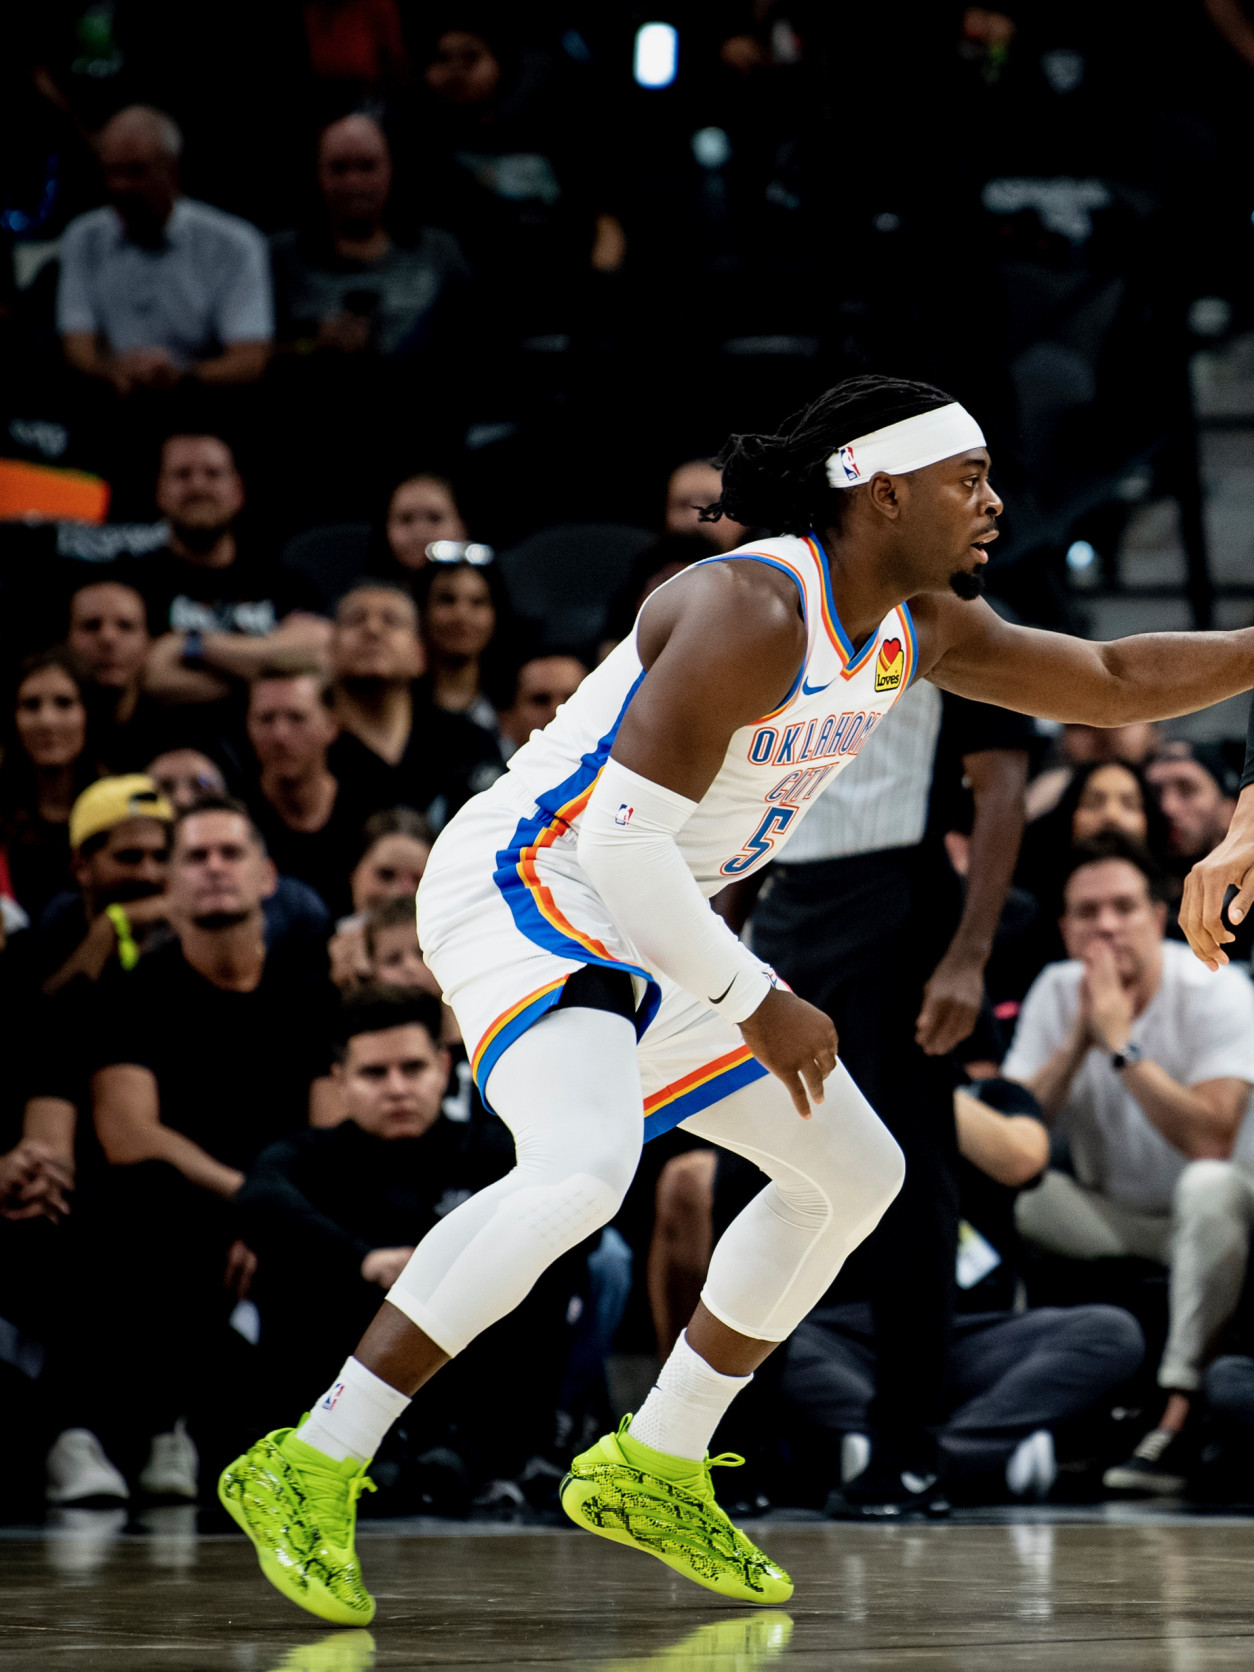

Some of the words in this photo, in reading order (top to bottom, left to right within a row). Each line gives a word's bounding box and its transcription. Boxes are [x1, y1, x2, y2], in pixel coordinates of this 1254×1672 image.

[748, 711, 881, 766] OKLAHOM
[765, 761, 840, 805] CITY
[720, 804, 799, 876] 5
